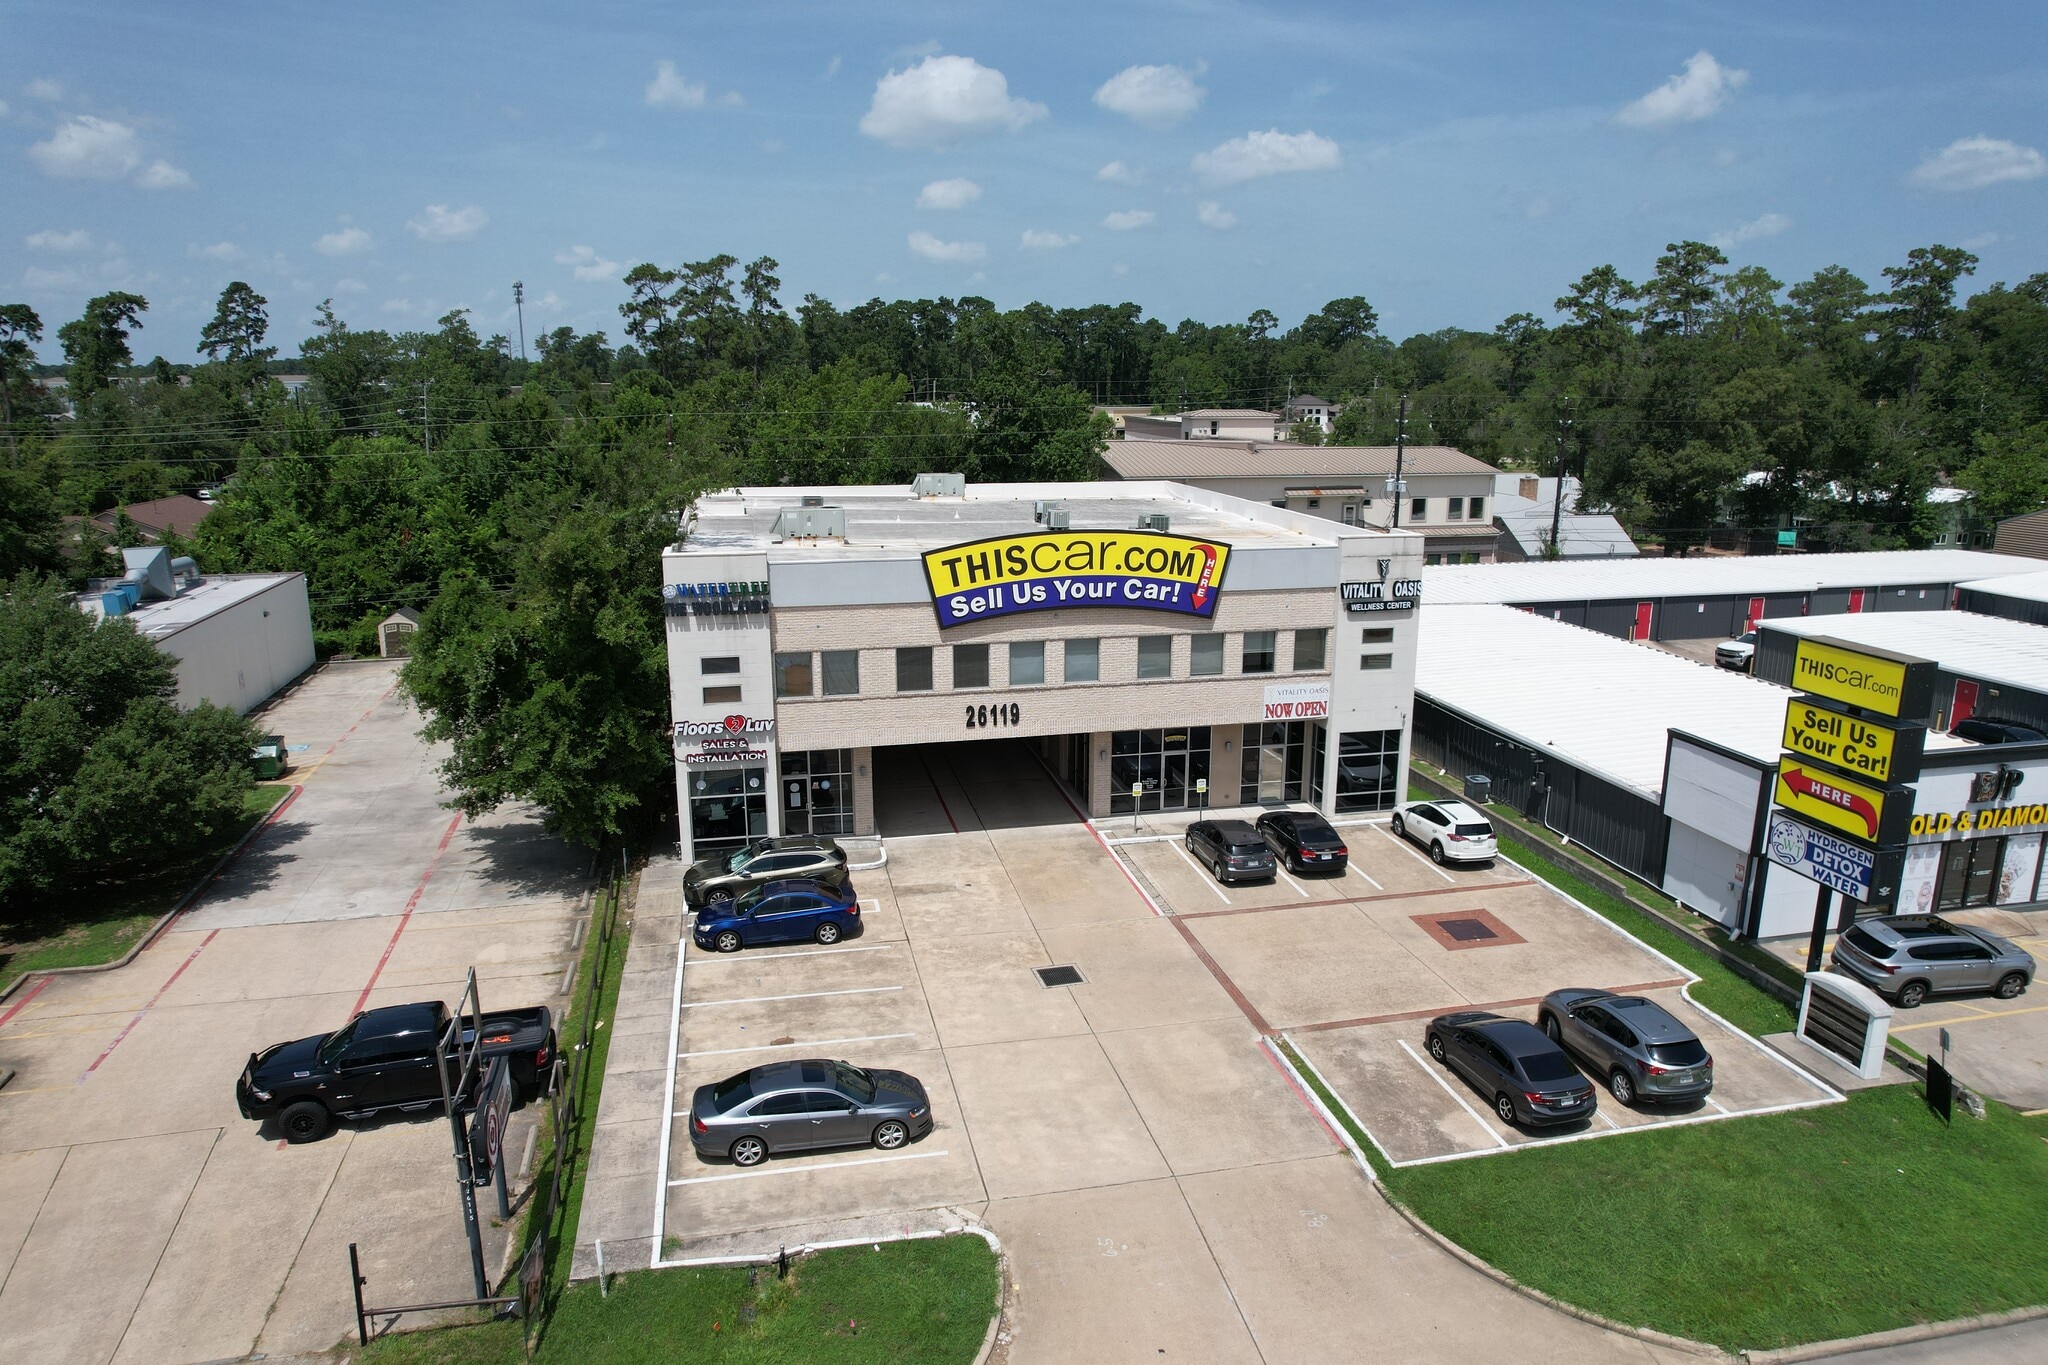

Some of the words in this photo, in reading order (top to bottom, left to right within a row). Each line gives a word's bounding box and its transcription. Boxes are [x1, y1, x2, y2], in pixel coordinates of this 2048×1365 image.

[1197, 558, 1215, 597] HERE
[951, 587, 1003, 618] Sell
[1012, 582, 1046, 605] Us
[1053, 579, 1117, 601] Your
[1123, 579, 1182, 603] Car!
[1342, 583, 1385, 599] VITALITY
[1394, 582, 1423, 597] OASIS
[663, 602, 687, 617] THE
[691, 600, 770, 616] WOODLANDS
[1351, 602, 1385, 611] WELLNESS
[1386, 601, 1411, 609] CENTER
[1277, 688, 1307, 696] VITALITY
[1309, 686, 1329, 695] OASIS
[965, 703, 1020, 728] 26119
[1264, 703, 1294, 719] NOW
[1295, 700, 1328, 717] OPEN
[674, 720, 724, 737] Floors
[730, 719, 740, 731] 2
[745, 717, 775, 732] Luv
[1803, 709, 1842, 738] Sell
[1849, 723, 1877, 749] Us
[687, 751, 767, 764] INSTALLATION
[702, 740, 736, 750] SALES
[739, 740, 748, 748] &
[1791, 726, 1837, 757] Your
[1842, 744, 1887, 775] Car!
[1810, 781, 1852, 807] HERE
[1909, 812, 1952, 836] OLD
[1957, 811, 1972, 832] &
[1807, 830, 1873, 866] HYDROGEN
[1812, 847, 1864, 881] DETOX
[1812, 864, 1859, 897] WATER
